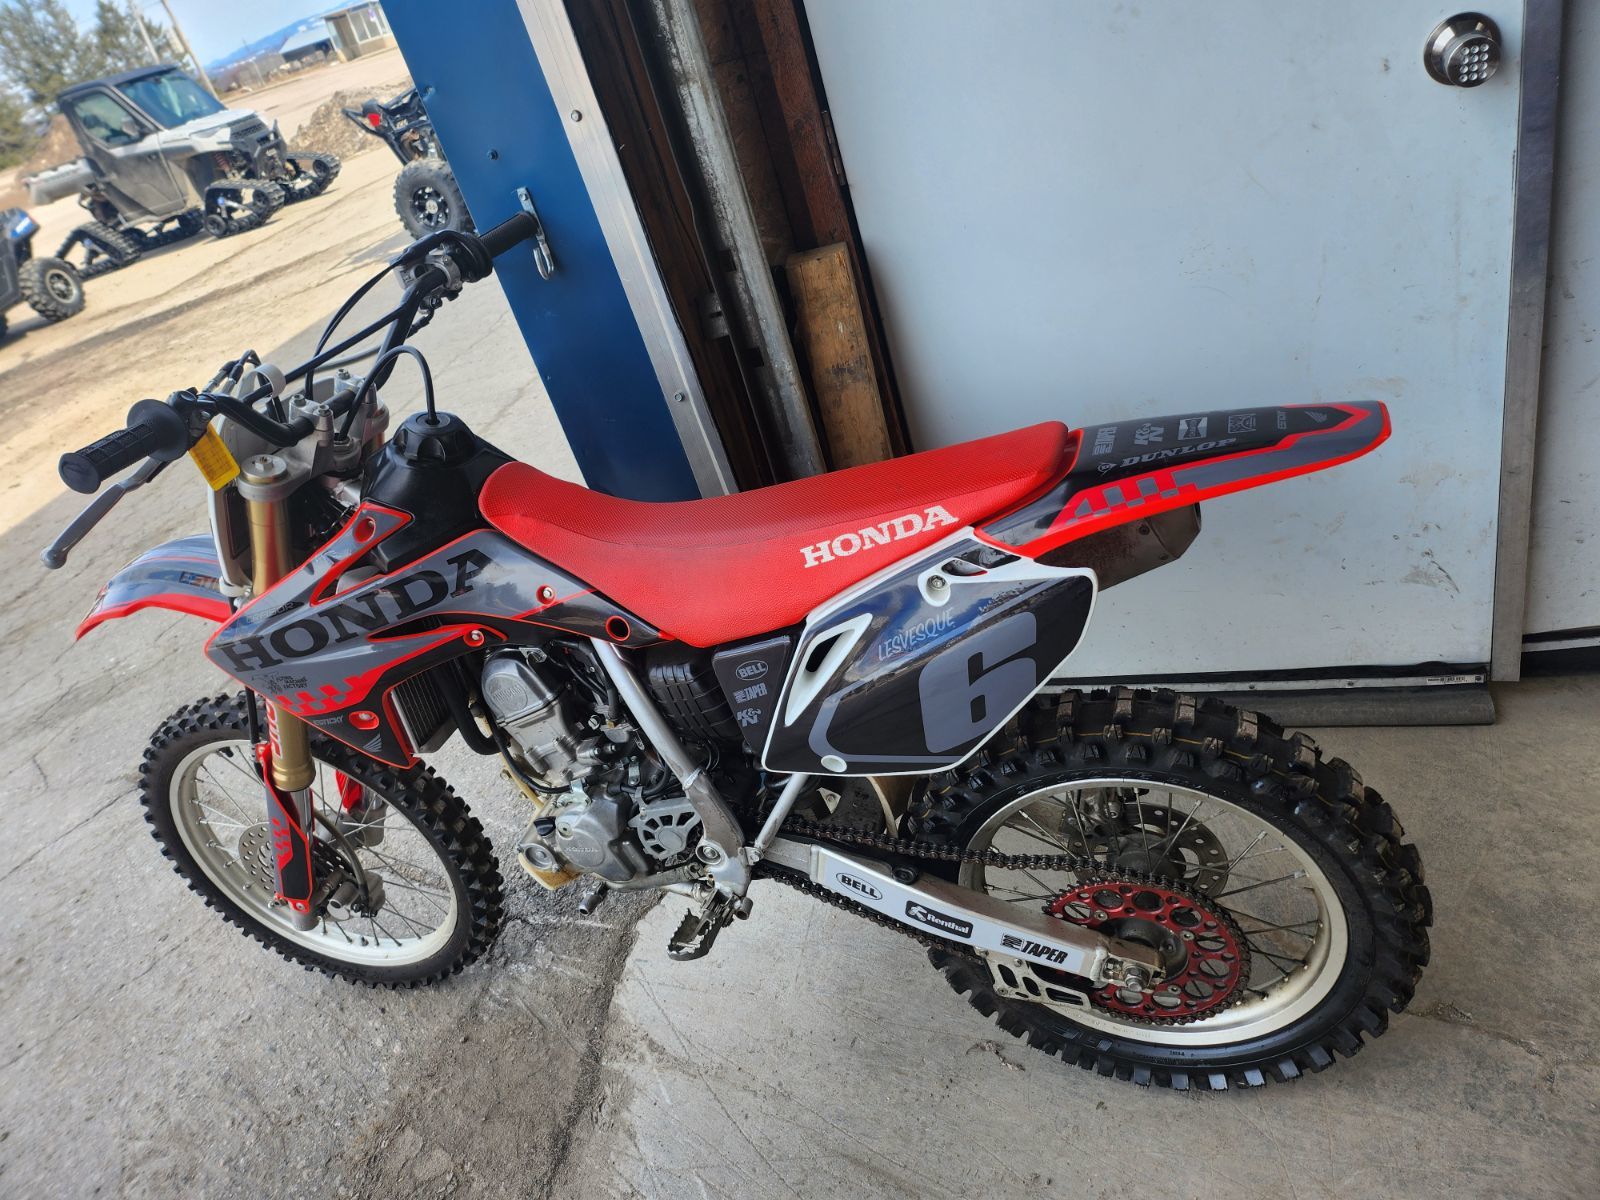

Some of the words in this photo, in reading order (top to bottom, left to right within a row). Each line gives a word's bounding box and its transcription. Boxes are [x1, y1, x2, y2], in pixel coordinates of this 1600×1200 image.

[1119, 437, 1237, 468] DUNLOP
[800, 505, 959, 568] HONDA
[217, 548, 493, 673] HONDA
[878, 607, 955, 662] LESVESQUE
[738, 662, 767, 678] BELL
[919, 611, 1037, 753] 6
[841, 874, 878, 899] BELL
[926, 914, 969, 934] Renthal
[1021, 940, 1068, 964] TAPER
